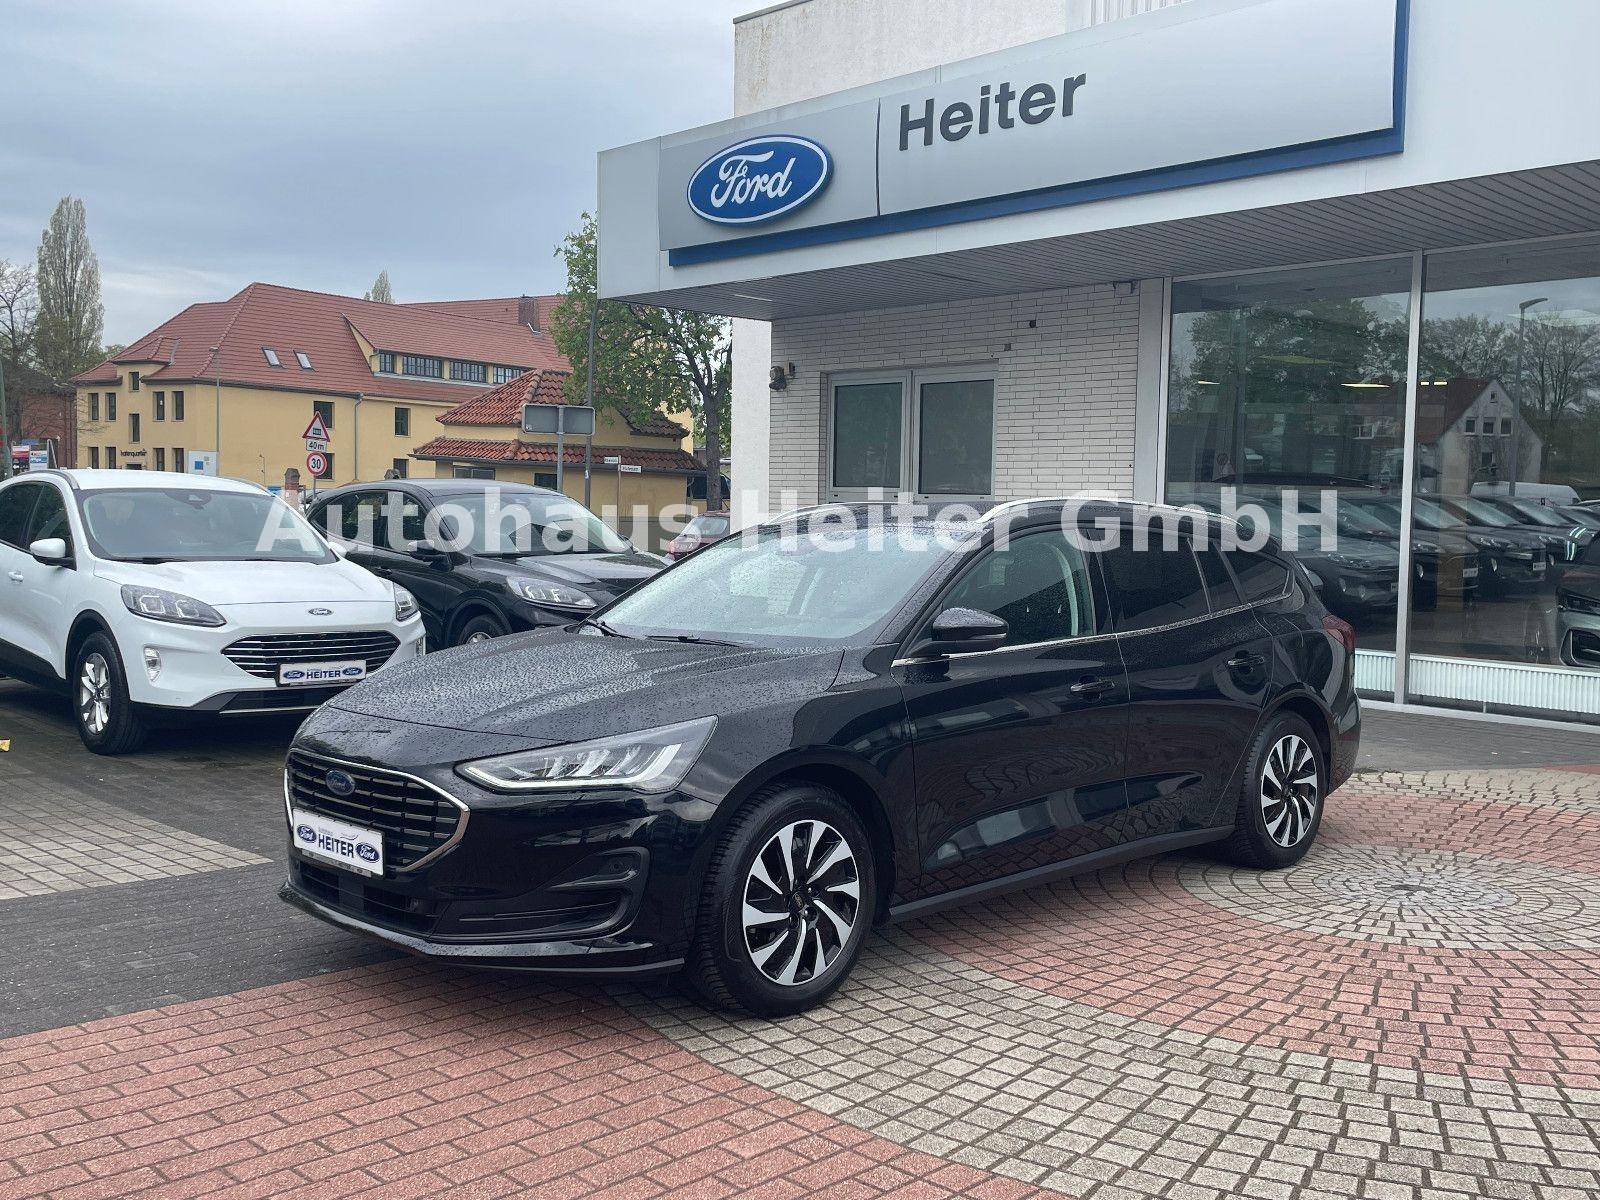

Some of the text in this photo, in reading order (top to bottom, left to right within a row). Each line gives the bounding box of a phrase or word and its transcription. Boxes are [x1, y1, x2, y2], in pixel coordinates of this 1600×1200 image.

[899, 73, 1086, 151] Heiter
[710, 150, 796, 208] Ford
[312, 458, 321, 469] 30
[307, 671, 340, 679] HEITER
[319, 834, 354, 858] HEITER
